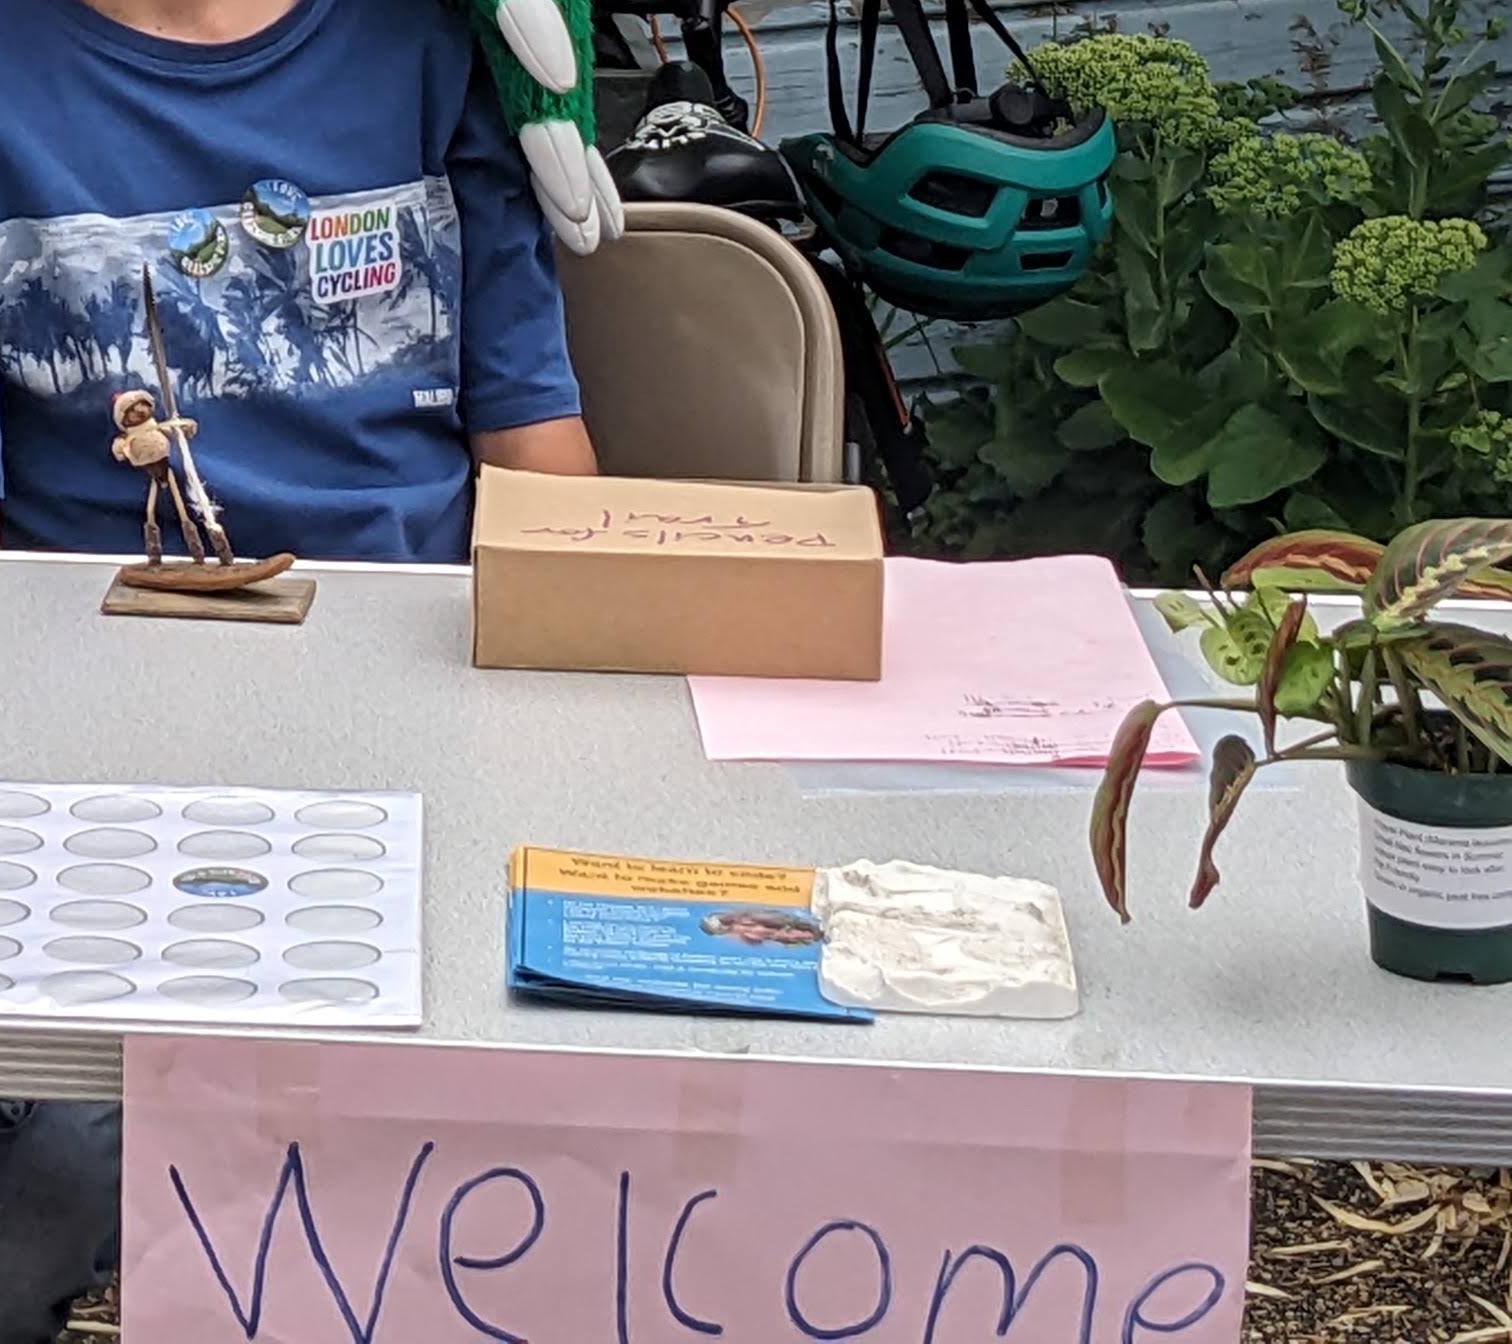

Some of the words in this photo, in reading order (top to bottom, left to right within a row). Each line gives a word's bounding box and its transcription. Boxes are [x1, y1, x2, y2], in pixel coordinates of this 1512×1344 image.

[310, 206, 390, 241] LONDON
[315, 231, 394, 274] LOVES
[317, 262, 396, 300] CYCLING
[169, 1139, 1226, 1344] Welcome
